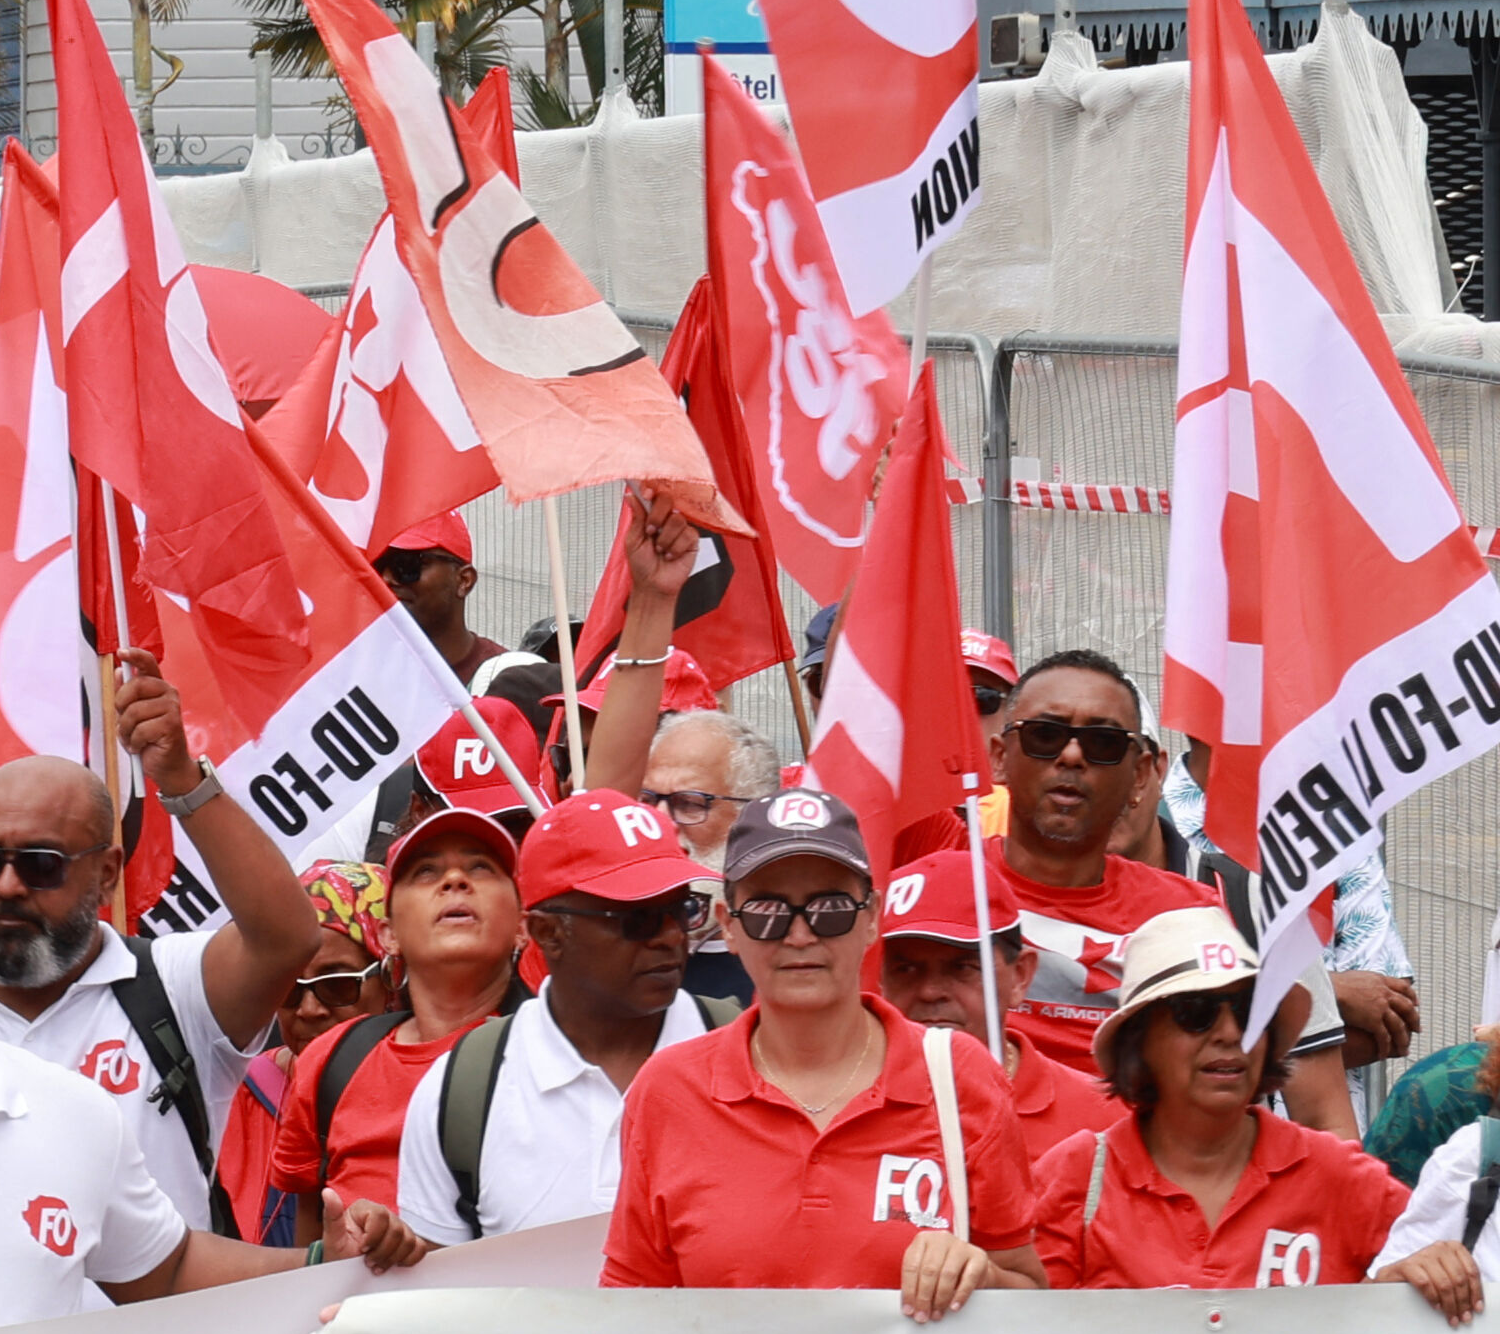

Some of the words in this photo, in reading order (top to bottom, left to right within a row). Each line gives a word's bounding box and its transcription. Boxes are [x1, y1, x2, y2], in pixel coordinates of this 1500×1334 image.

[960, 641, 988, 657] gtr
[612, 804, 662, 847] FO
[781, 797, 819, 821] FO
[885, 873, 925, 916] FO
[1202, 944, 1237, 971] FO
[90, 1048, 132, 1084] FO
[874, 1154, 943, 1228] FO
[39, 1206, 76, 1246] FO
[1257, 1229, 1321, 1288] FO
